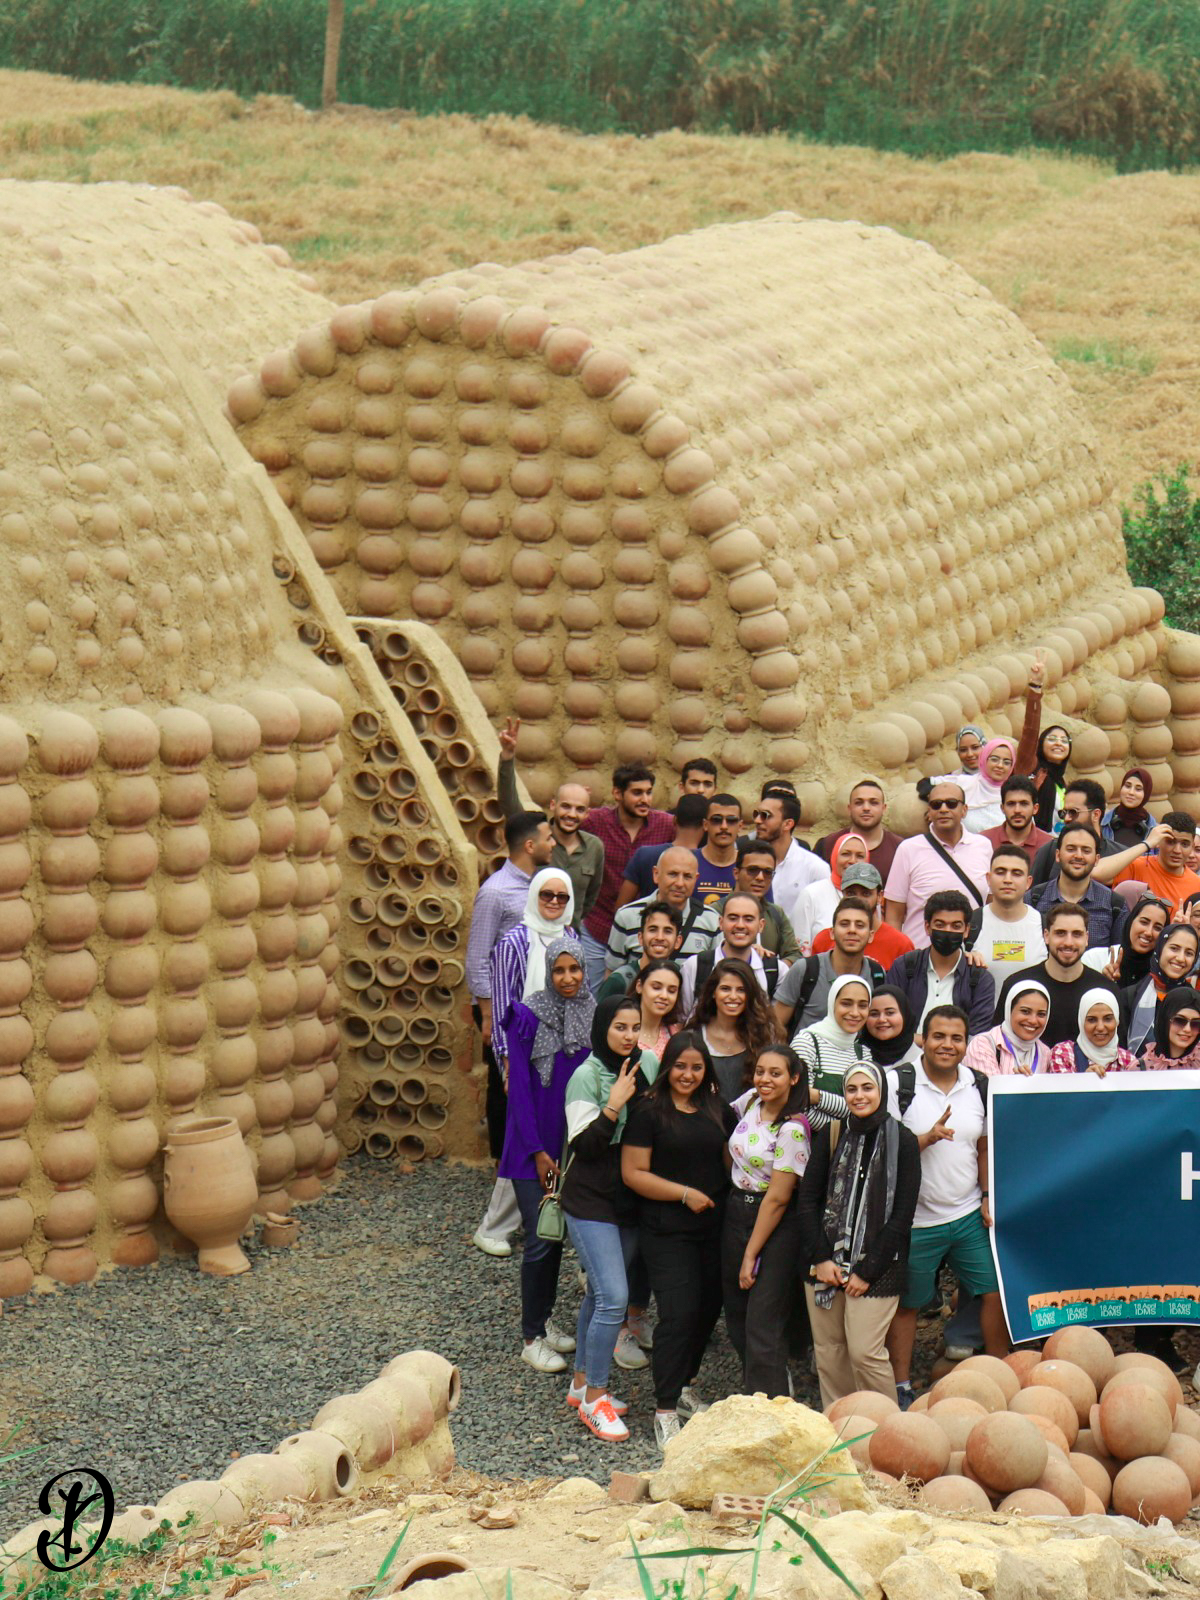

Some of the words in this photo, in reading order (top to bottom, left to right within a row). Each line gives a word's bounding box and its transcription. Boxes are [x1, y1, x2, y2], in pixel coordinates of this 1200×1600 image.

[1074, 1306, 1088, 1314] April
[1176, 1302, 1191, 1310] April
[1042, 1311, 1055, 1319] April
[1101, 1309, 1122, 1317] IDMS
[1135, 1308, 1156, 1316] IDMS
[1170, 1308, 1191, 1316] IDMS
[1068, 1312, 1088, 1321] IDMS
[1037, 1317, 1056, 1327] IDMS
